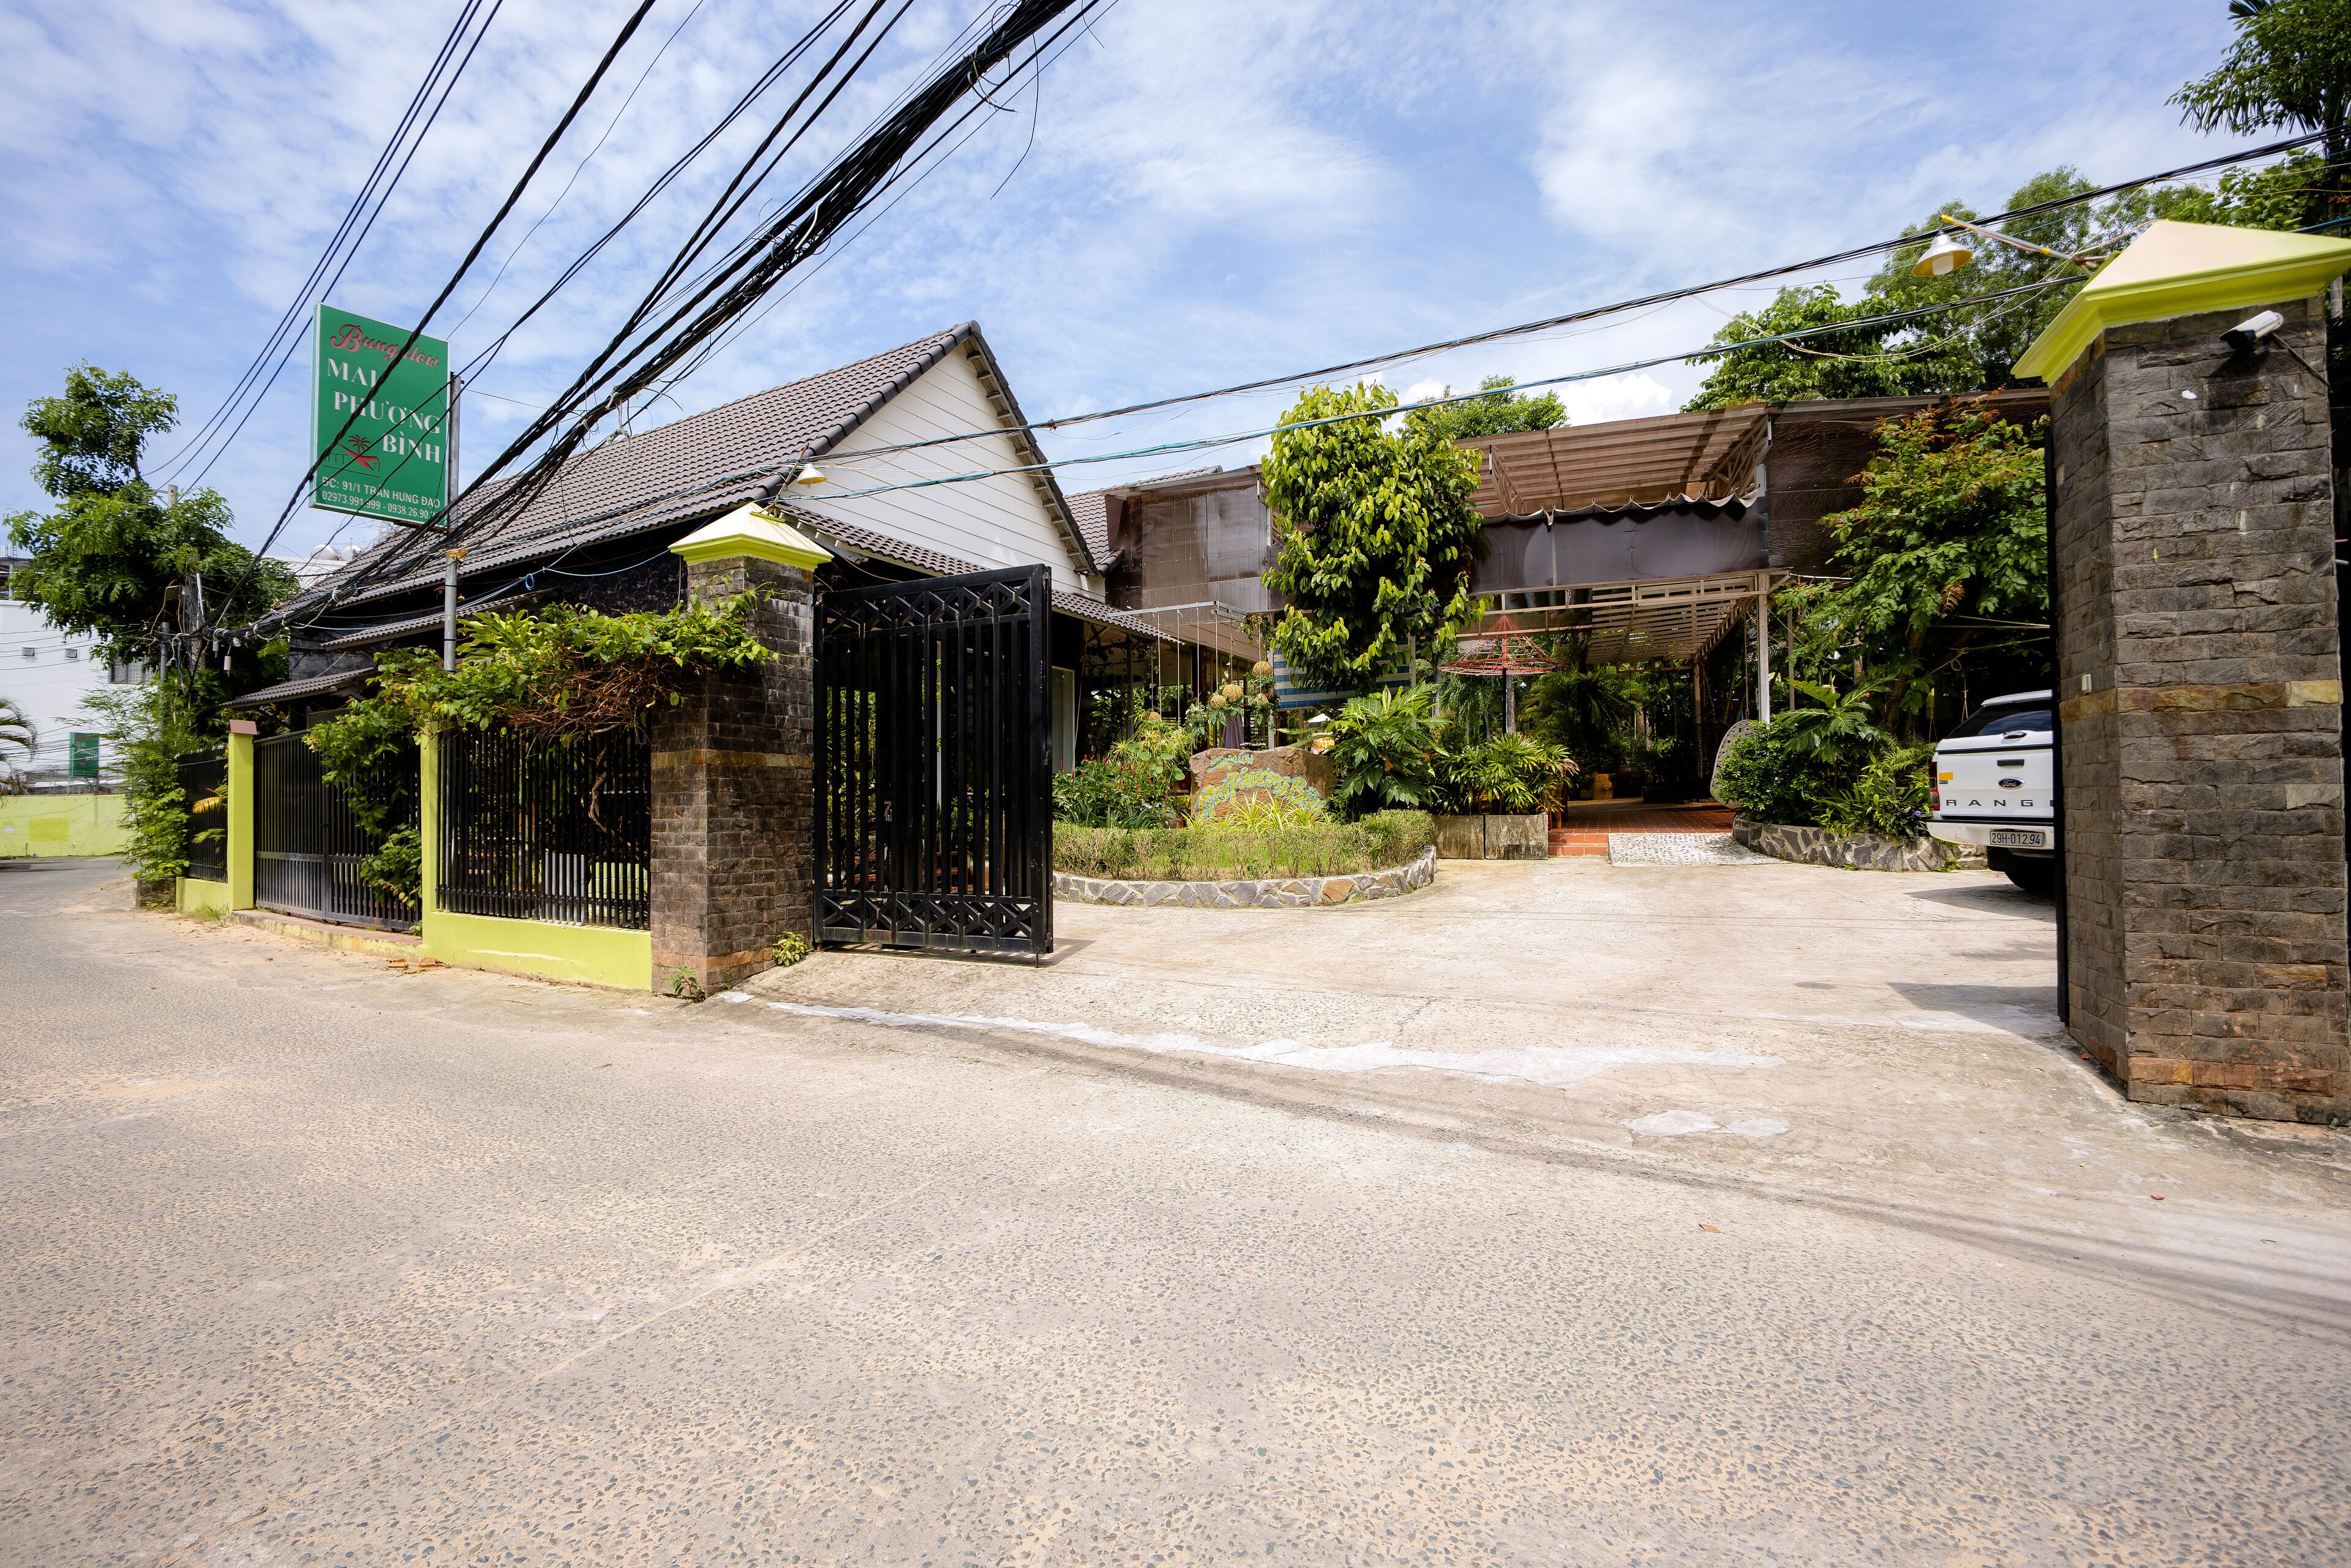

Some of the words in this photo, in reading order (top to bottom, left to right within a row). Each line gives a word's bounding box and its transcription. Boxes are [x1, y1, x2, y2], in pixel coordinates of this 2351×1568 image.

[328, 358, 377, 387] MAI
[334, 391, 440, 433] PHƯƠNG
[382, 431, 440, 463] BÌNH
[321, 476, 339, 489] ĐC:
[342, 481, 360, 492] 91/1
[392, 490, 419, 504] HƯNG
[421, 496, 440, 509] ĐẠO
[322, 491, 380, 509] 02973.991.999
[388, 503, 438, 519] 0938.26.90.
[1992, 833, 2040, 845] 29H-012.94
